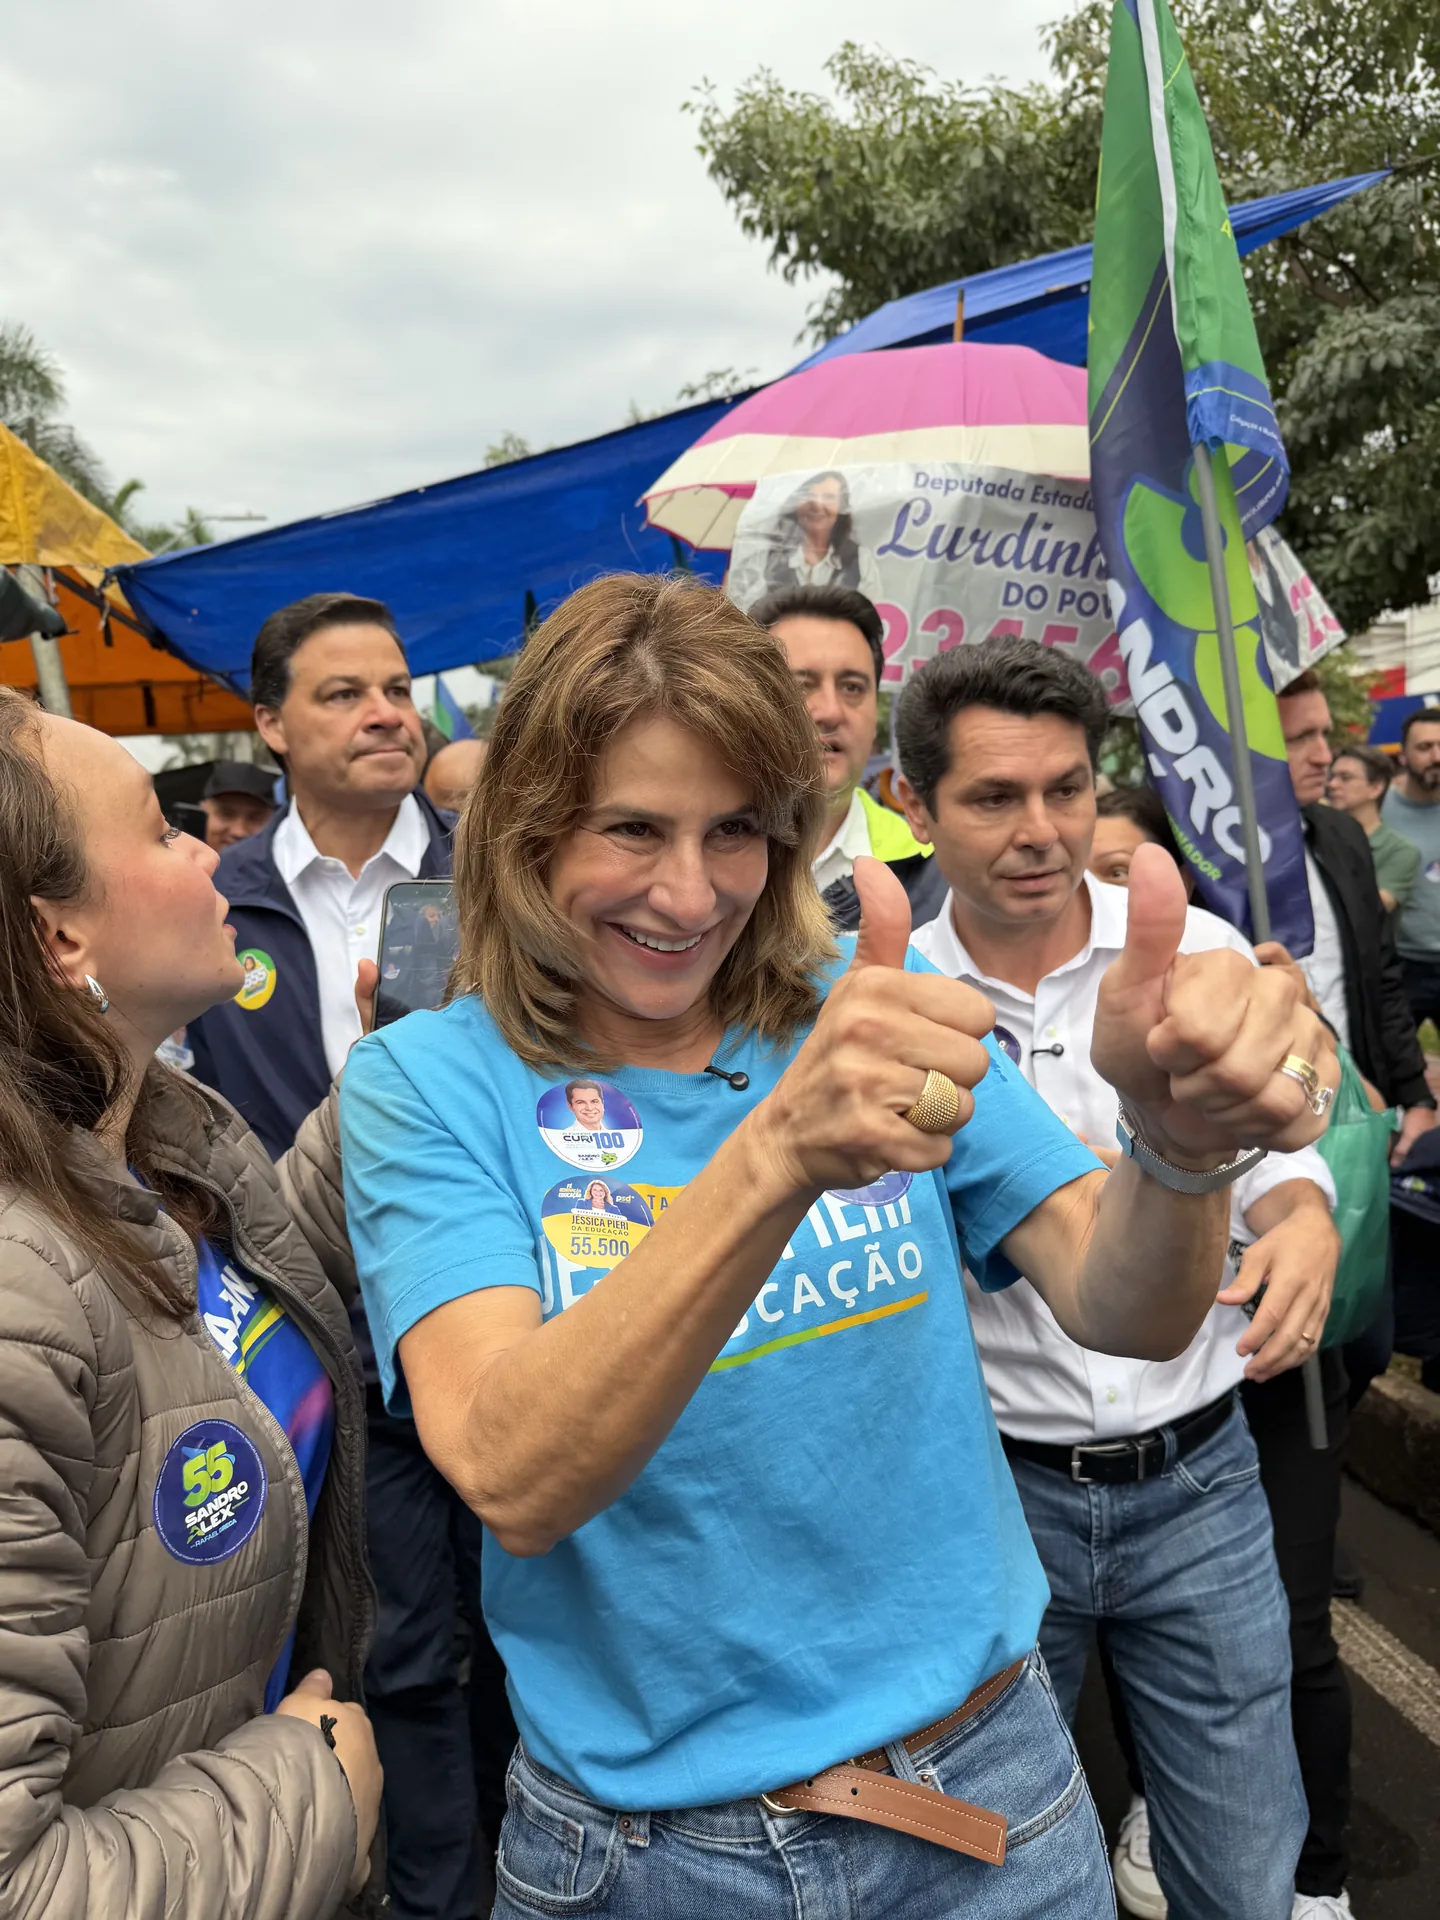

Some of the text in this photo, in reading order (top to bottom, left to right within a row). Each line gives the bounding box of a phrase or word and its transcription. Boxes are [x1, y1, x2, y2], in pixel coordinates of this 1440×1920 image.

[913, 472, 1025, 502] Deputada
[1002, 580, 1049, 612] DO
[563, 1135, 594, 1143] CURI
[591, 1132, 624, 1149] 100
[585, 1227, 629, 1237] EDUCAÇÃO
[607, 1219, 629, 1231] PIERI
[570, 1236, 630, 1257] 55.500
[183, 1440, 234, 1507] 55
[184, 1480, 249, 1529] SANDRO
[186, 1503, 235, 1545] ALEX
[195, 1529, 220, 1548] RAFAEL
